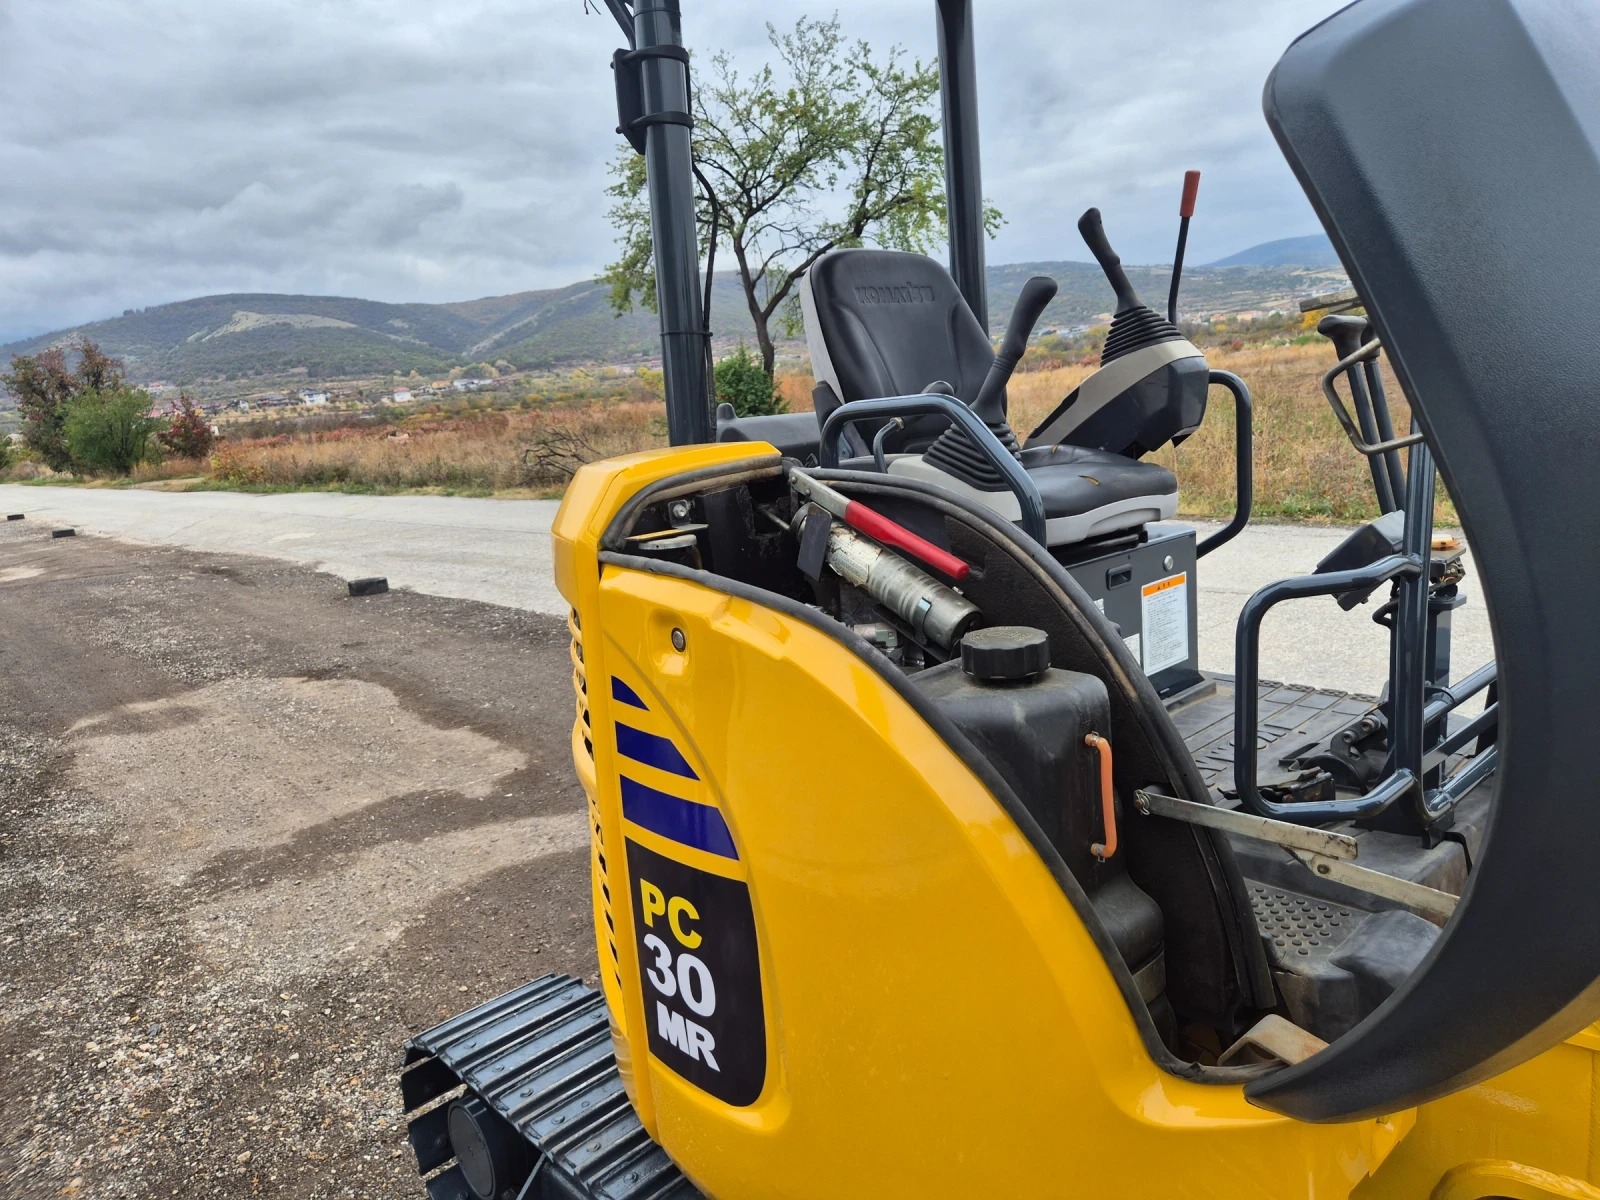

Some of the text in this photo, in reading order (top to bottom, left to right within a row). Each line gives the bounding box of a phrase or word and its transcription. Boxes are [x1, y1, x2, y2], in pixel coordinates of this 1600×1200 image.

[854, 282, 935, 304] KOMATSU
[640, 879, 702, 949] PC
[644, 933, 716, 1017] 30
[657, 1001, 720, 1072] MR
